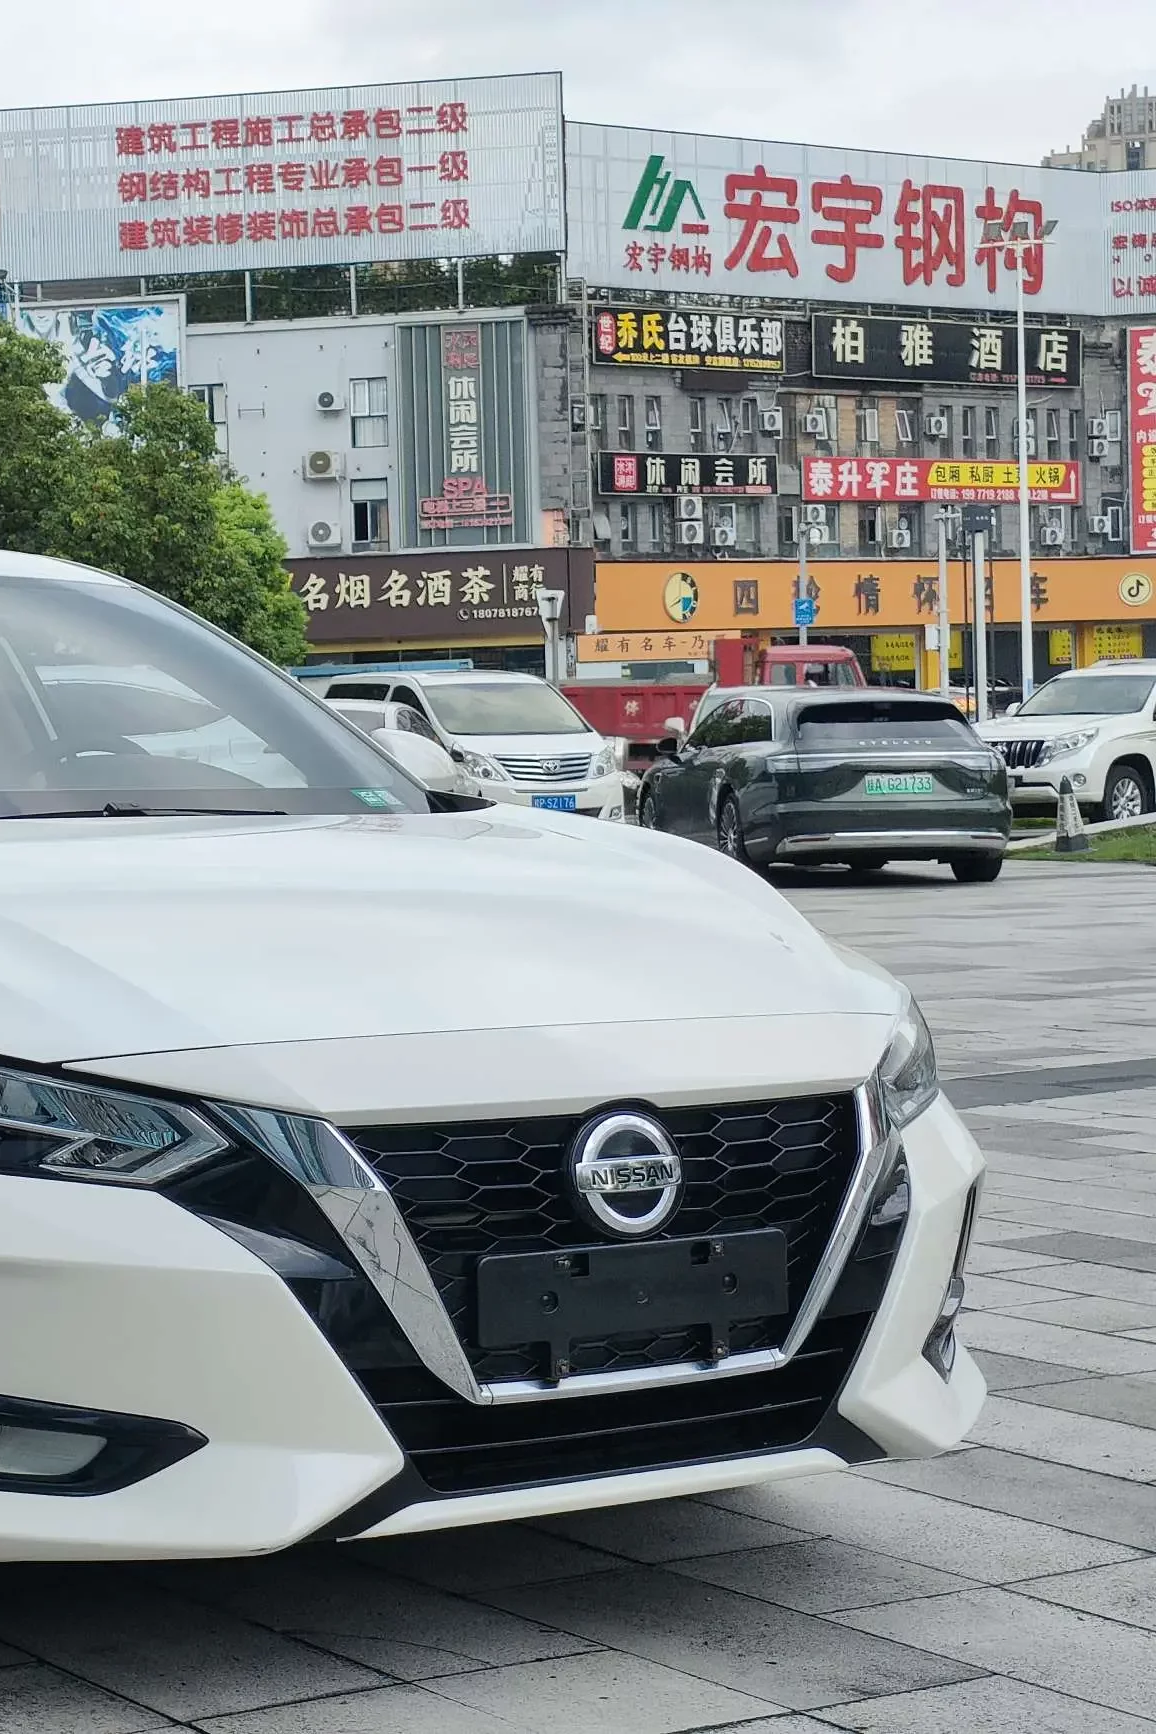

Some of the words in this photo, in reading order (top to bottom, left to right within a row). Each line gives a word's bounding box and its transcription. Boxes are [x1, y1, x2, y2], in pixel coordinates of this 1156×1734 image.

[115, 102, 469, 157] 建筑工程施工总承包二级
[117, 151, 470, 203] 钢结构工程专业承包一级
[119, 199, 471, 251] 建筑装修装饰总承包二级
[724, 165, 1043, 295] 宏宇钢构
[622, 241, 712, 278] 宏宇钢构
[617, 311, 783, 356] 乔氏台球俱乐部
[832, 318, 1070, 373] 柏雅酒店
[447, 375, 479, 474] 休闲会所
[442, 477, 487, 498] SPA
[645, 457, 769, 487] 休闲会所
[808, 459, 920, 499] 泰升羊庄
[936, 465, 960, 483] 包厢
[969, 465, 994, 484] 私厨
[1035, 466, 1060, 485] 火锅
[300, 567, 497, 612] 名烟名酒茶
[471, 606, 541, 619] 1807818767
[590, 1163, 674, 1186] NISSAN
